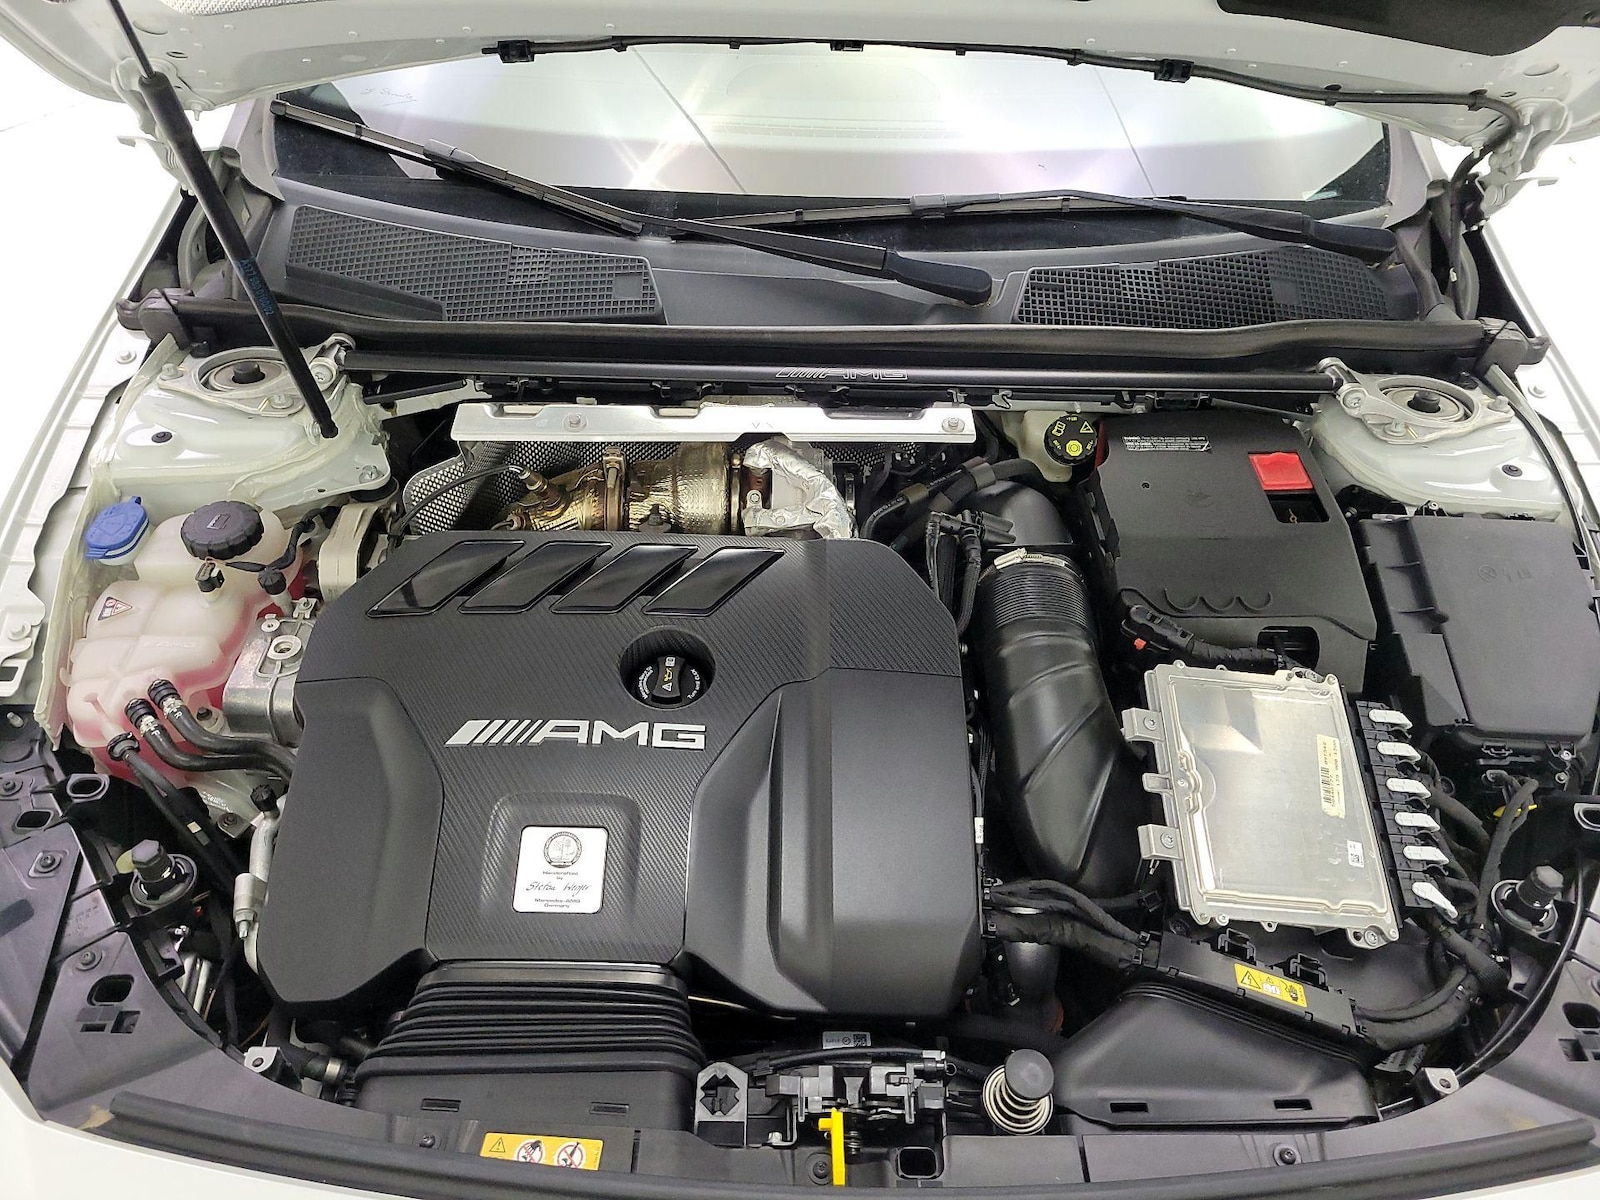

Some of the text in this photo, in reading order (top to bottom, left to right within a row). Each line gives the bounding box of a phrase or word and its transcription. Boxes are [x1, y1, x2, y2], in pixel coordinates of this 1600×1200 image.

[819, 367, 908, 380] AMG
[527, 719, 706, 751] AMG
[543, 902, 570, 910] Germany
